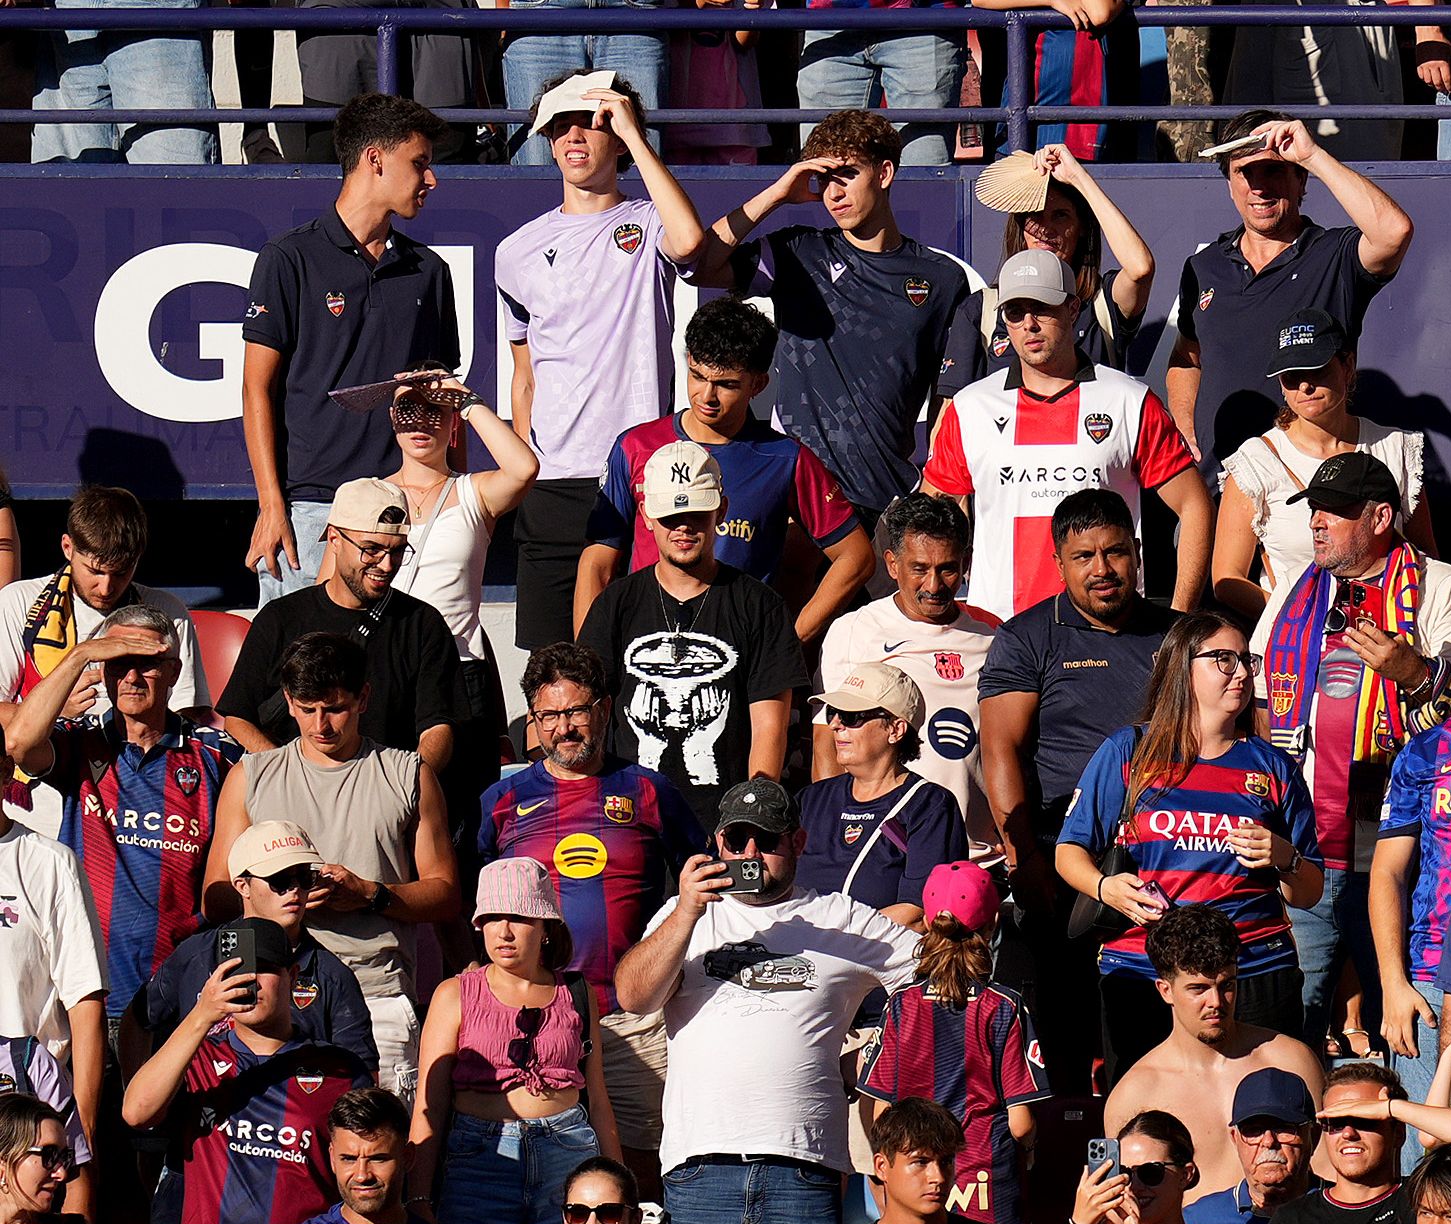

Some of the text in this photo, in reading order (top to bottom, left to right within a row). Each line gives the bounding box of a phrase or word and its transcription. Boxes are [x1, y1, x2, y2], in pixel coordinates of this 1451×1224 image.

[671, 462, 691, 484] NY
[1000, 466, 1101, 484] MARCOS
[715, 518, 755, 543] otify
[1063, 658, 1109, 670] marathon
[84, 797, 200, 837] MARCOS
[116, 833, 199, 854] automoción
[264, 836, 303, 853] LALIGA
[1174, 835, 1236, 855] AIRWA
